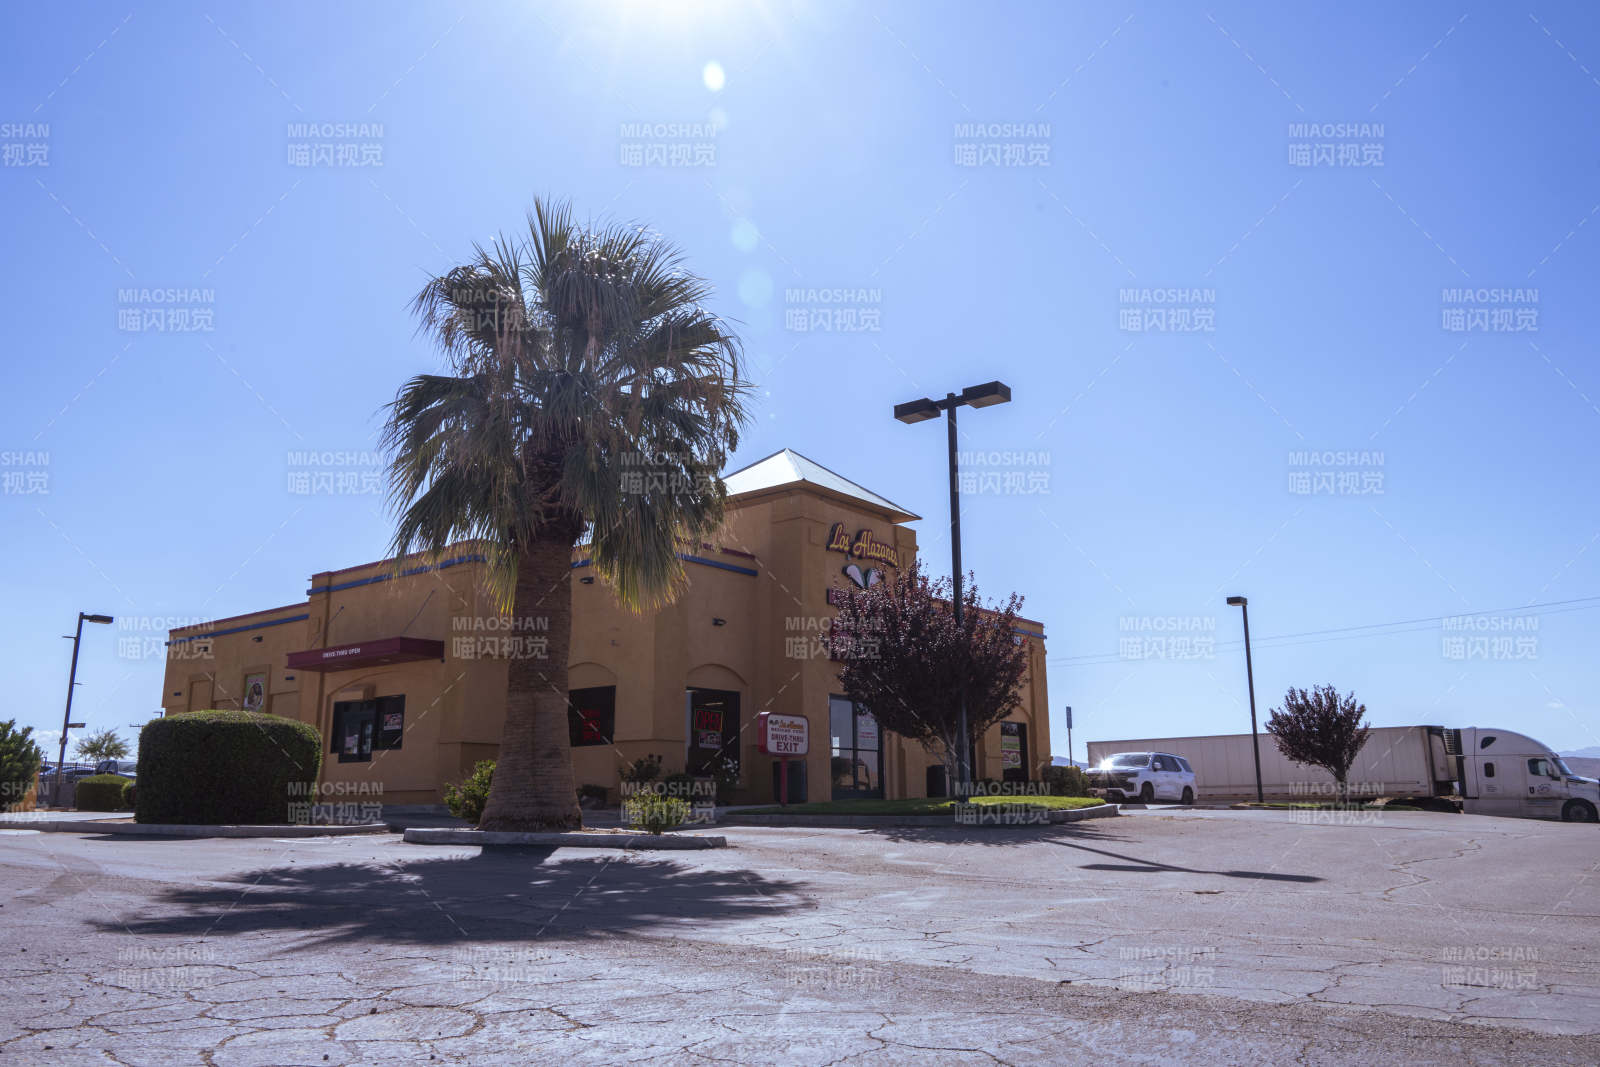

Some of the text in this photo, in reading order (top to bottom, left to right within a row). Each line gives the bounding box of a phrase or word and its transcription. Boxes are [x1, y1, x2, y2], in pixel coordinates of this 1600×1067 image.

[829, 523, 848, 551] Los
[348, 647, 361, 655] OPEN
[696, 711, 720, 731] OPEN
[771, 733, 804, 743] DRIVE-THRU
[777, 742, 799, 752] EXIT
